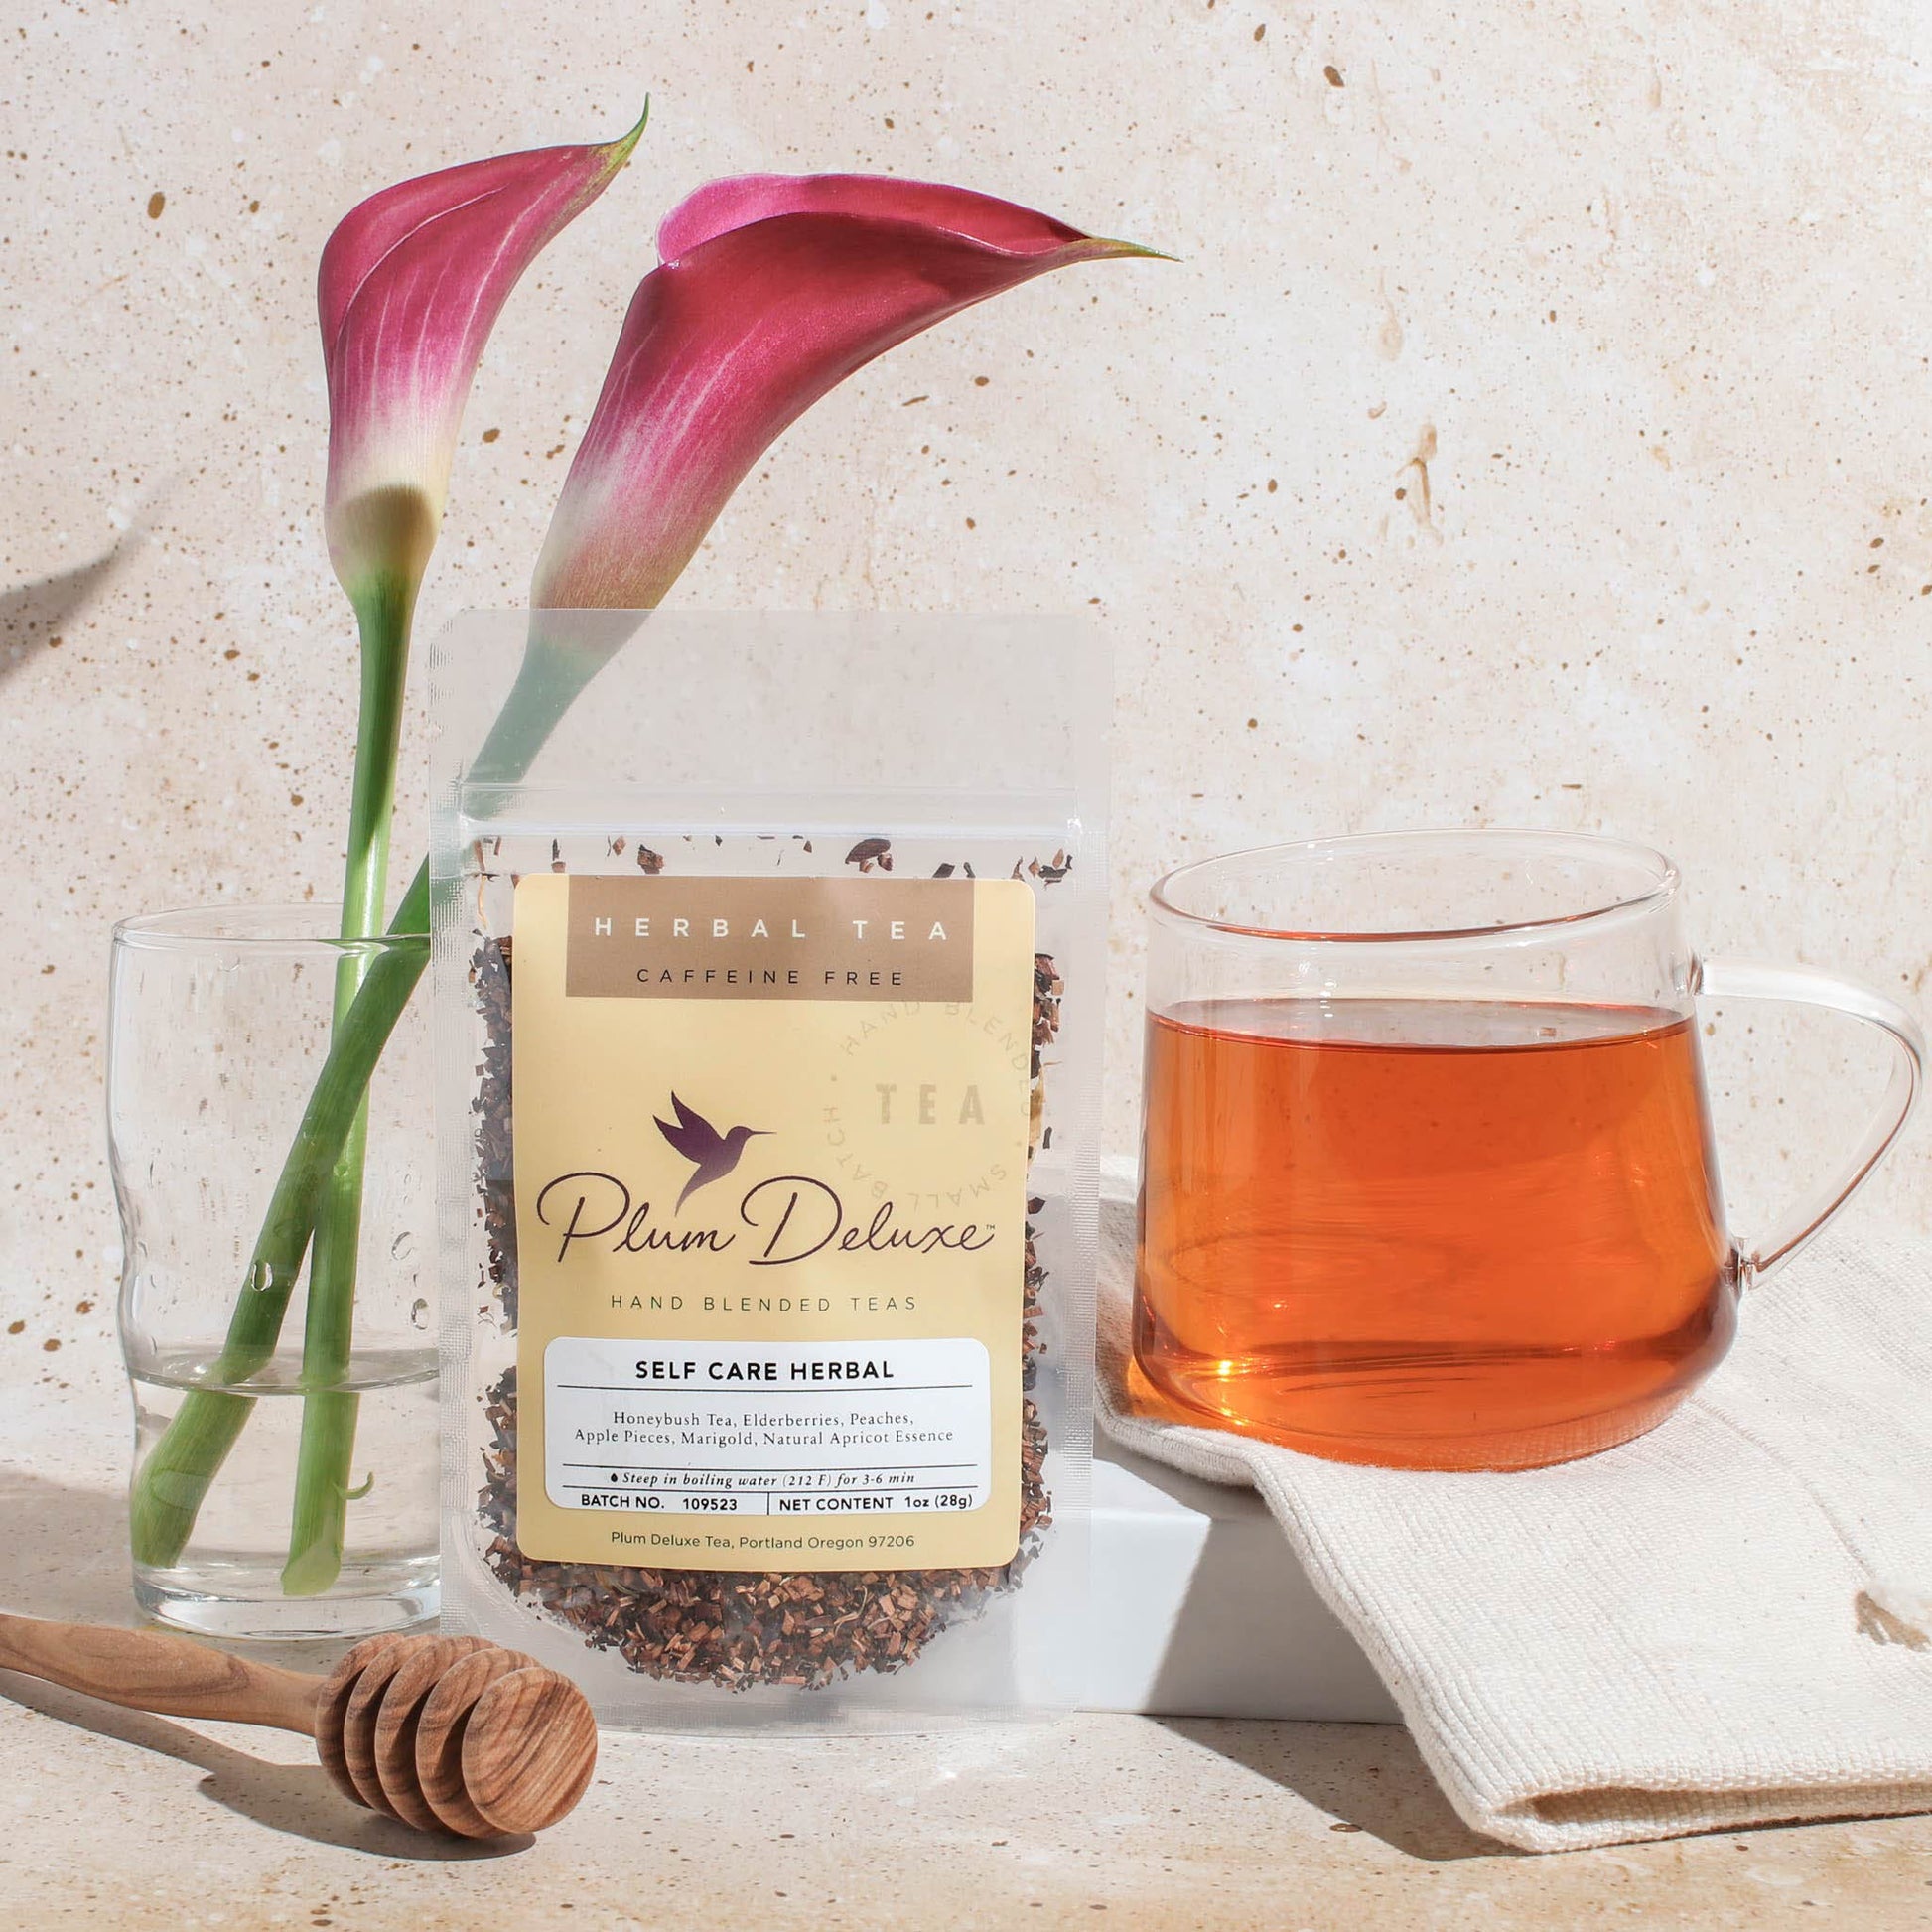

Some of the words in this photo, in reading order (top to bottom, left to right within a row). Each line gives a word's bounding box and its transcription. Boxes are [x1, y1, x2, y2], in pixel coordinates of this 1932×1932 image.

[595, 917, 806, 938] HERBAL
[852, 919, 947, 941] TEA
[636, 968, 799, 985] CAFFEINE
[824, 970, 902, 986] FREE
[875, 1083, 985, 1125] TEA
[536, 1171, 737, 1263] Plum
[740, 1175, 995, 1266] Deluxe
[611, 1294, 683, 1311] HAND
[703, 1296, 830, 1312] BLENDED
[849, 1296, 915, 1311] TEAS
[634, 1360, 697, 1380] SELF
[707, 1361, 778, 1382] CARE
[790, 1360, 895, 1381] HERBAL
[613, 1411, 700, 1429] Honeybush
[706, 1413, 738, 1428] Tea,
[743, 1413, 845, 1428] Elderberries,
[850, 1410, 914, 1426] Peaches,
[574, 1428, 619, 1446] Apple
[624, 1429, 676, 1445] Pieces,
[681, 1431, 758, 1449] Marigold,
[762, 1431, 823, 1446] Natural
[829, 1432, 889, 1449] Apricot
[896, 1429, 953, 1443] Essence
[622, 1472, 658, 1488] Steep
[663, 1472, 677, 1485] in
[683, 1472, 733, 1489] boiling
[738, 1475, 777, 1486] water
[782, 1474, 812, 1487] (212
[834, 1472, 858, 1489] for
[862, 1473, 883, 1486] 3-6
[888, 1471, 915, 1484] min
[581, 1493, 630, 1508] BATCH
[635, 1495, 665, 1510] NO.
[682, 1497, 738, 1511] 109523
[779, 1498, 812, 1512] NET
[815, 1496, 895, 1511] CONTENT
[904, 1495, 930, 1508] 1oz
[934, 1493, 973, 1510] (28g)
[611, 1531, 646, 1545] Plum
[650, 1533, 701, 1548] Deluxe
[704, 1535, 735, 1550] Tea,
[739, 1536, 803, 1550] Portland
[807, 1536, 864, 1551] Oregon
[868, 1534, 915, 1548] 97206
